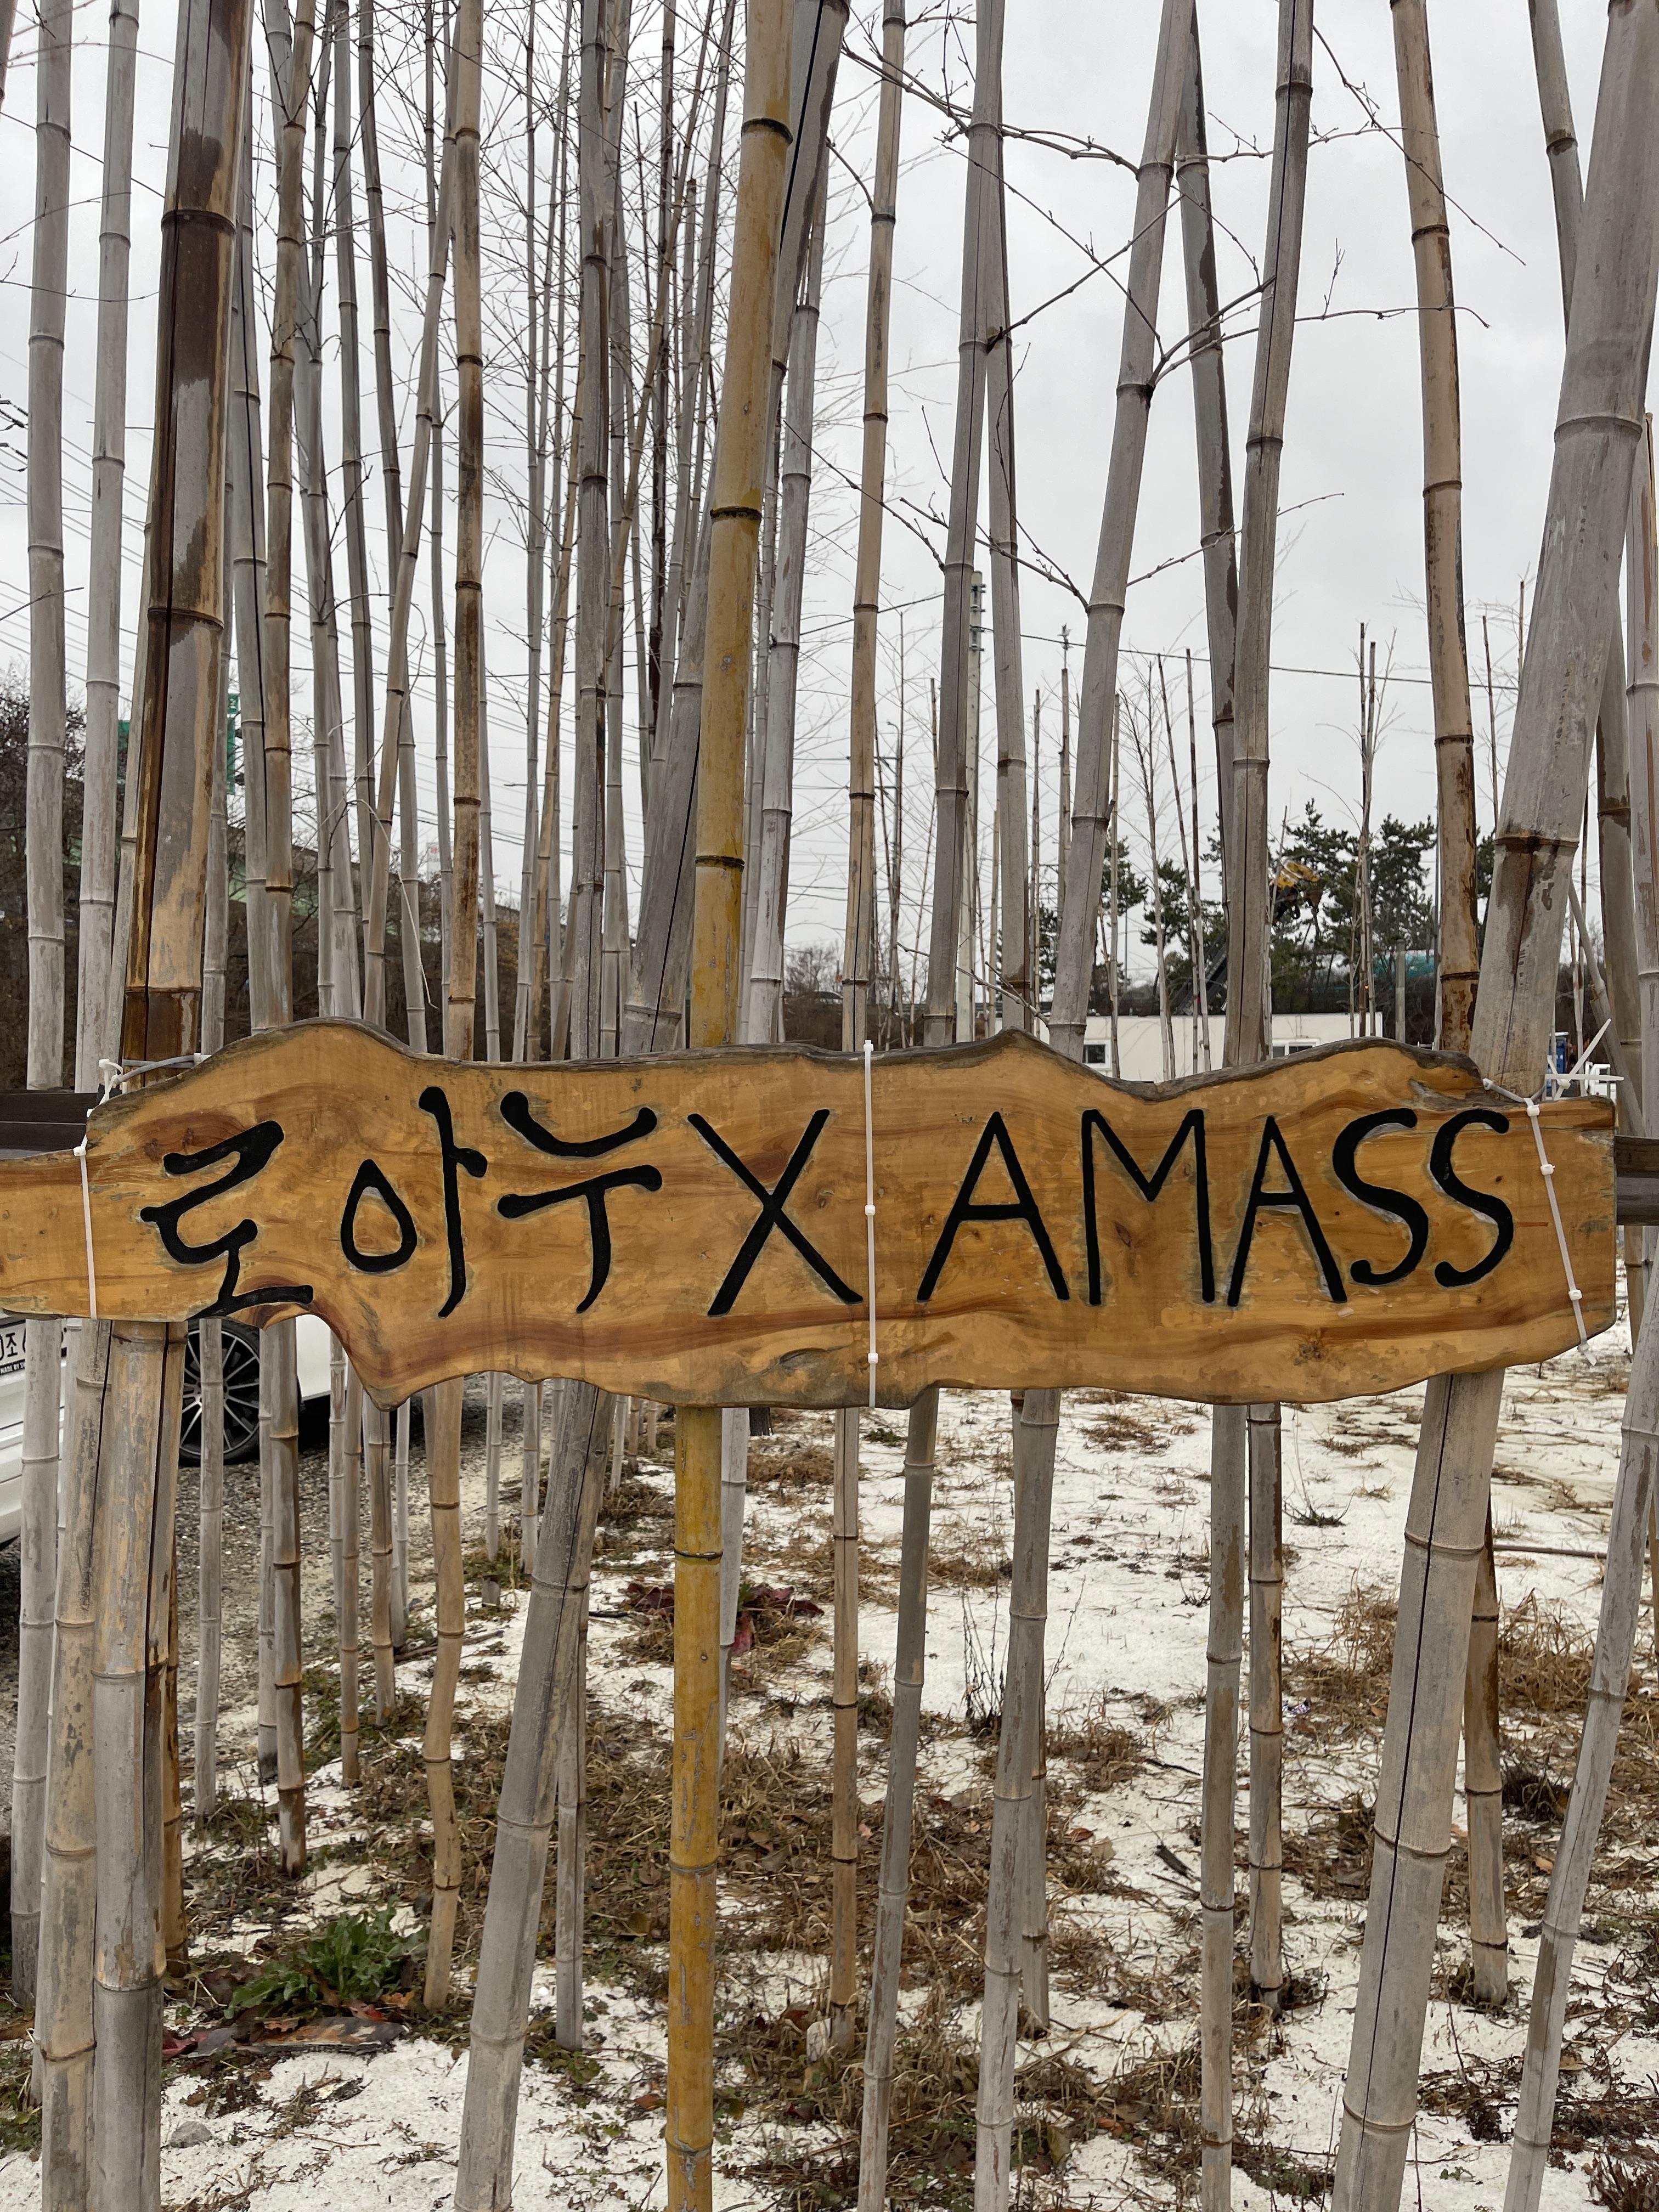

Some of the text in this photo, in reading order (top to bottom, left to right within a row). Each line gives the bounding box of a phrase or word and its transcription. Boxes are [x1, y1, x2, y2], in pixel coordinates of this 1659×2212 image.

[139, 1086, 1515, 1321] 로아누 X AMASS
